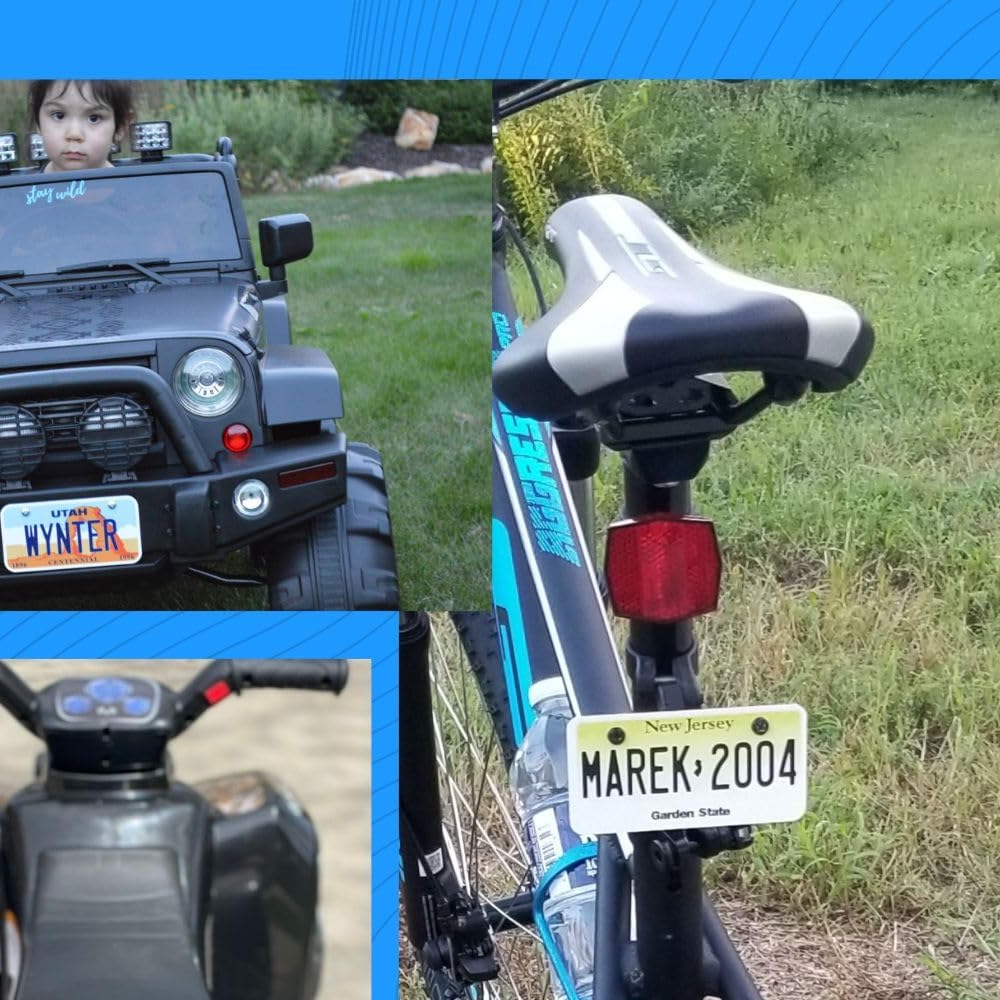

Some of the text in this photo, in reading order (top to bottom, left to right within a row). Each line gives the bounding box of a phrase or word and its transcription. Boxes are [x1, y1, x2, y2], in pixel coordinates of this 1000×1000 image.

[26, 180, 87, 205] stay wild
[498, 400, 582, 568] AGGRES
[51, 508, 88, 518] UTAH
[24, 518, 118, 557] WYNTER
[48, 557, 98, 566] CENTENNIAL
[644, 717, 735, 734] New Jersey
[581, 738, 797, 799] MAREK 2004
[650, 807, 731, 821] Garden State
